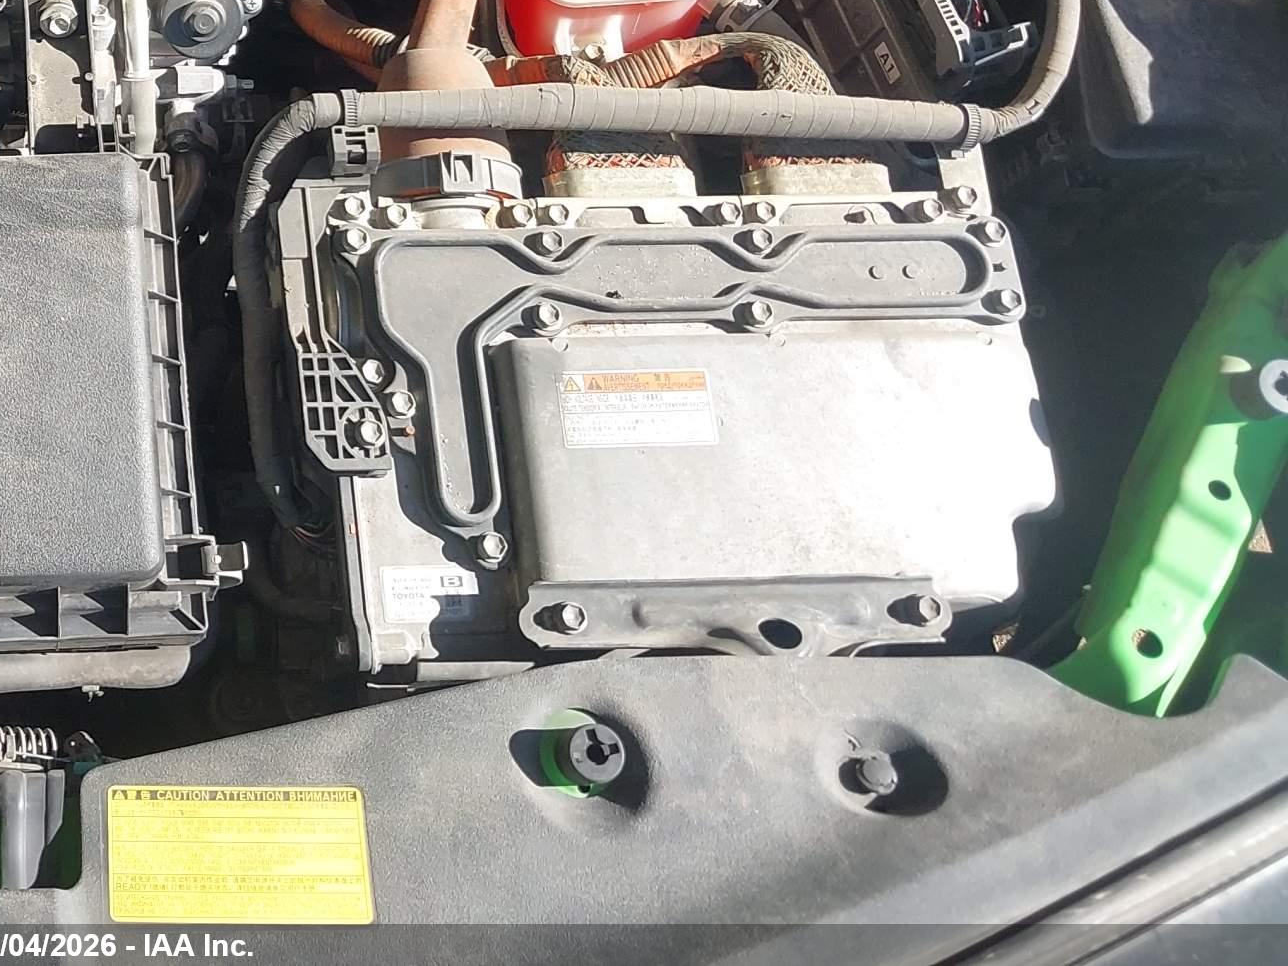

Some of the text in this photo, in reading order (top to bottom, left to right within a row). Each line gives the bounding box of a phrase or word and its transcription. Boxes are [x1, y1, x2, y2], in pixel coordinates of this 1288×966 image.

[879, 53, 895, 72] A1
[602, 374, 639, 383] WARNING
[156, 790, 210, 801] CAUTION
[215, 790, 283, 802] ATTENTION
[289, 791, 356, 802] ВНИМАНИЕ
